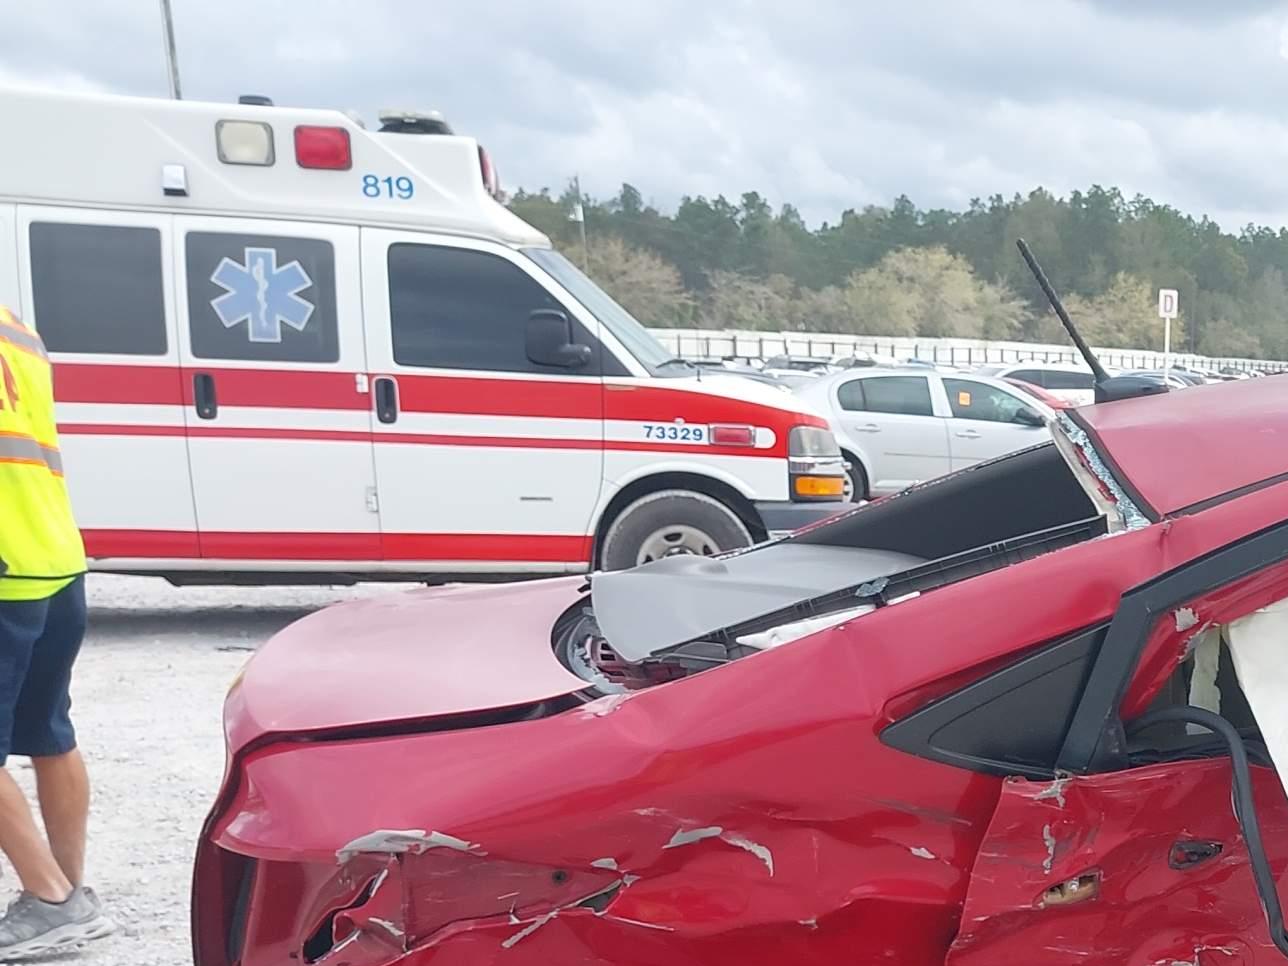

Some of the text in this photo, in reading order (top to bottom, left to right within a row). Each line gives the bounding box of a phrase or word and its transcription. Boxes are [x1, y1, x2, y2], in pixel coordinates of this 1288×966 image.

[362, 174, 414, 200] 819
[1163, 294, 1174, 313] D
[642, 425, 704, 442] 73329
